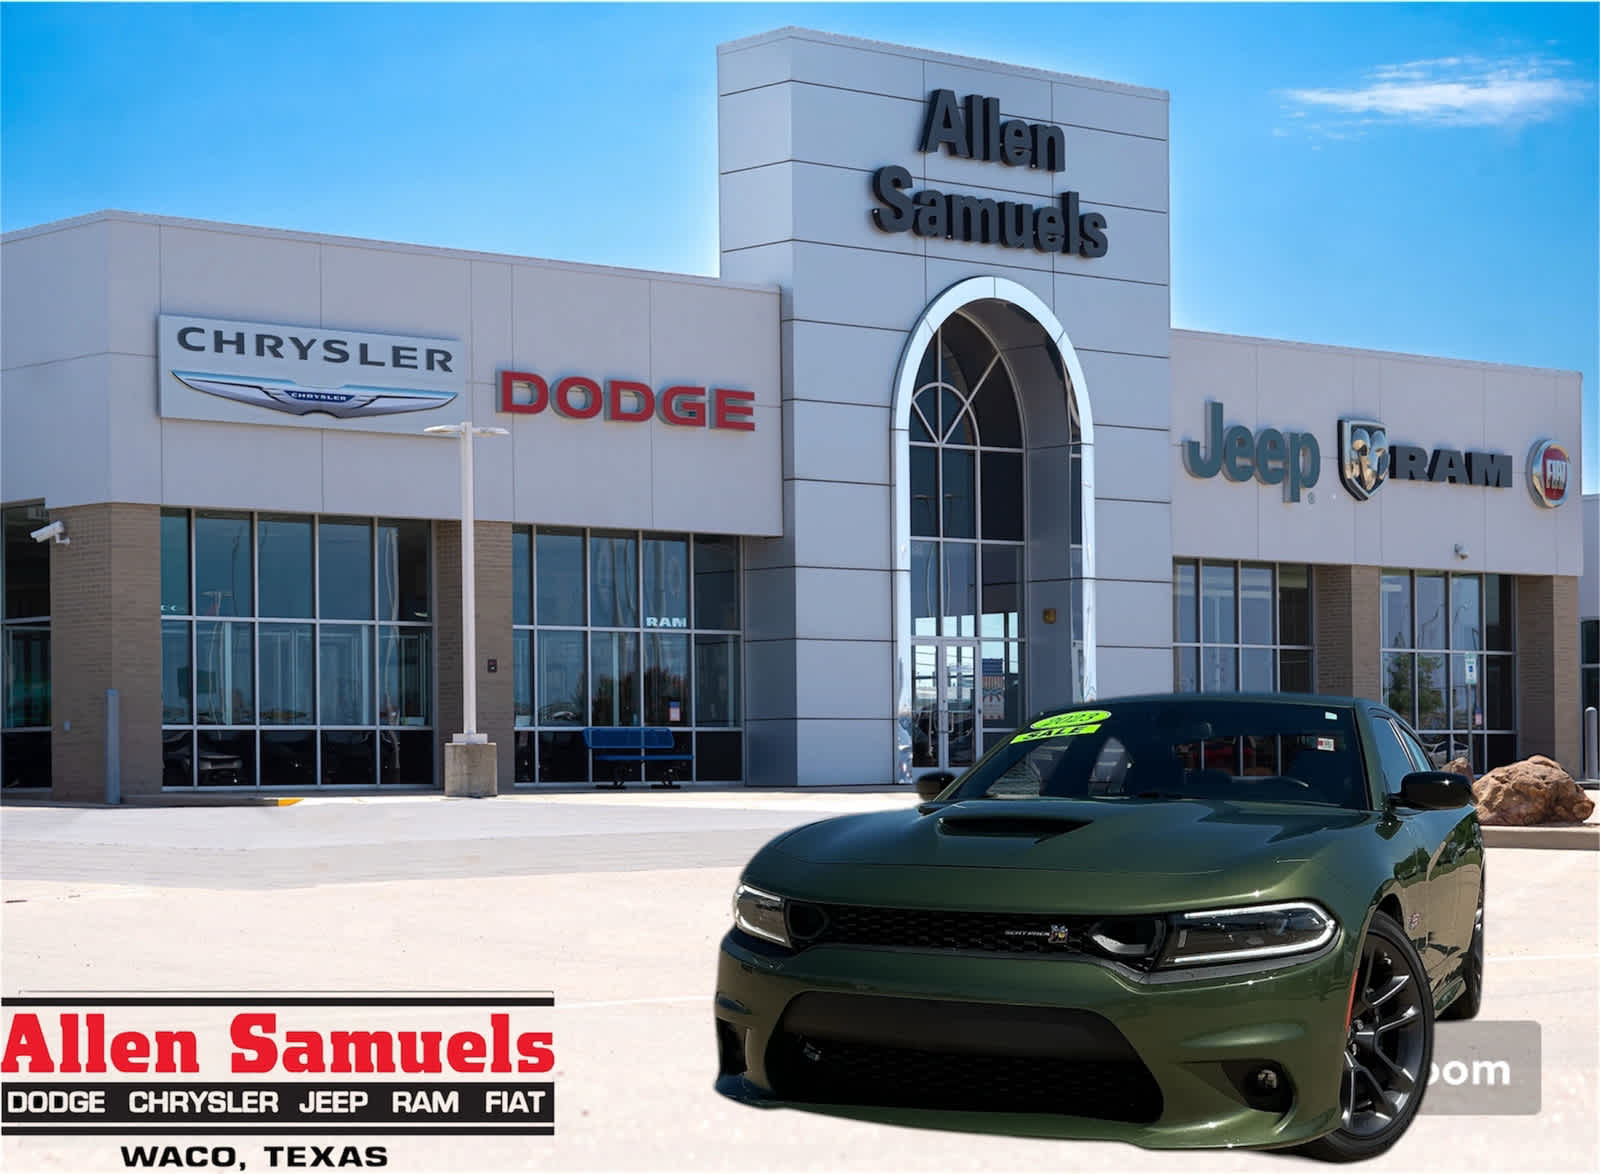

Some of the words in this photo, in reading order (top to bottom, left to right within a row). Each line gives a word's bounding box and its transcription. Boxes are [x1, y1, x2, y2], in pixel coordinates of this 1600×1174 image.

[920, 88, 1066, 172] Allen
[872, 164, 1108, 258] Samuels
[177, 326, 454, 373] CHRYSLER
[291, 392, 347, 401] CHRYSLER
[497, 370, 756, 432] DODGE
[1182, 401, 1321, 503] Jeep
[1389, 445, 1513, 488] RAM
[1545, 459, 1567, 489] FIAT
[646, 616, 687, 628] RAM
